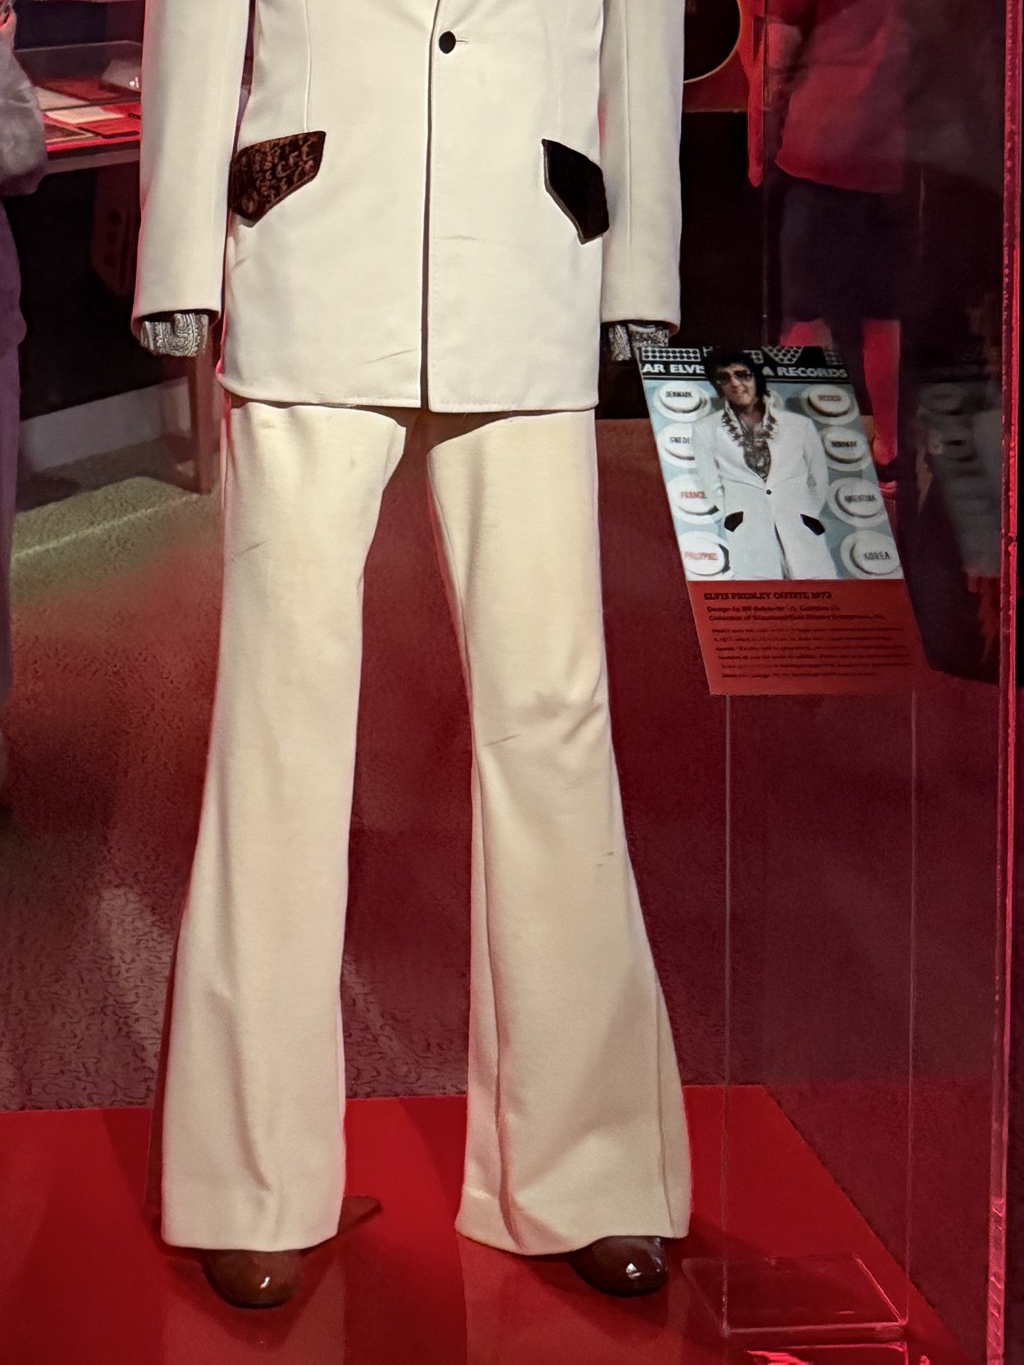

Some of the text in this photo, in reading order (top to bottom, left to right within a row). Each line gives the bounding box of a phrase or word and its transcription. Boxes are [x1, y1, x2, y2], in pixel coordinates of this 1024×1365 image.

[777, 366, 848, 377] RECORDS
[864, 551, 890, 560] KOREA
[704, 592, 729, 600] ELVIS
[730, 592, 771, 600] PRESLEY
